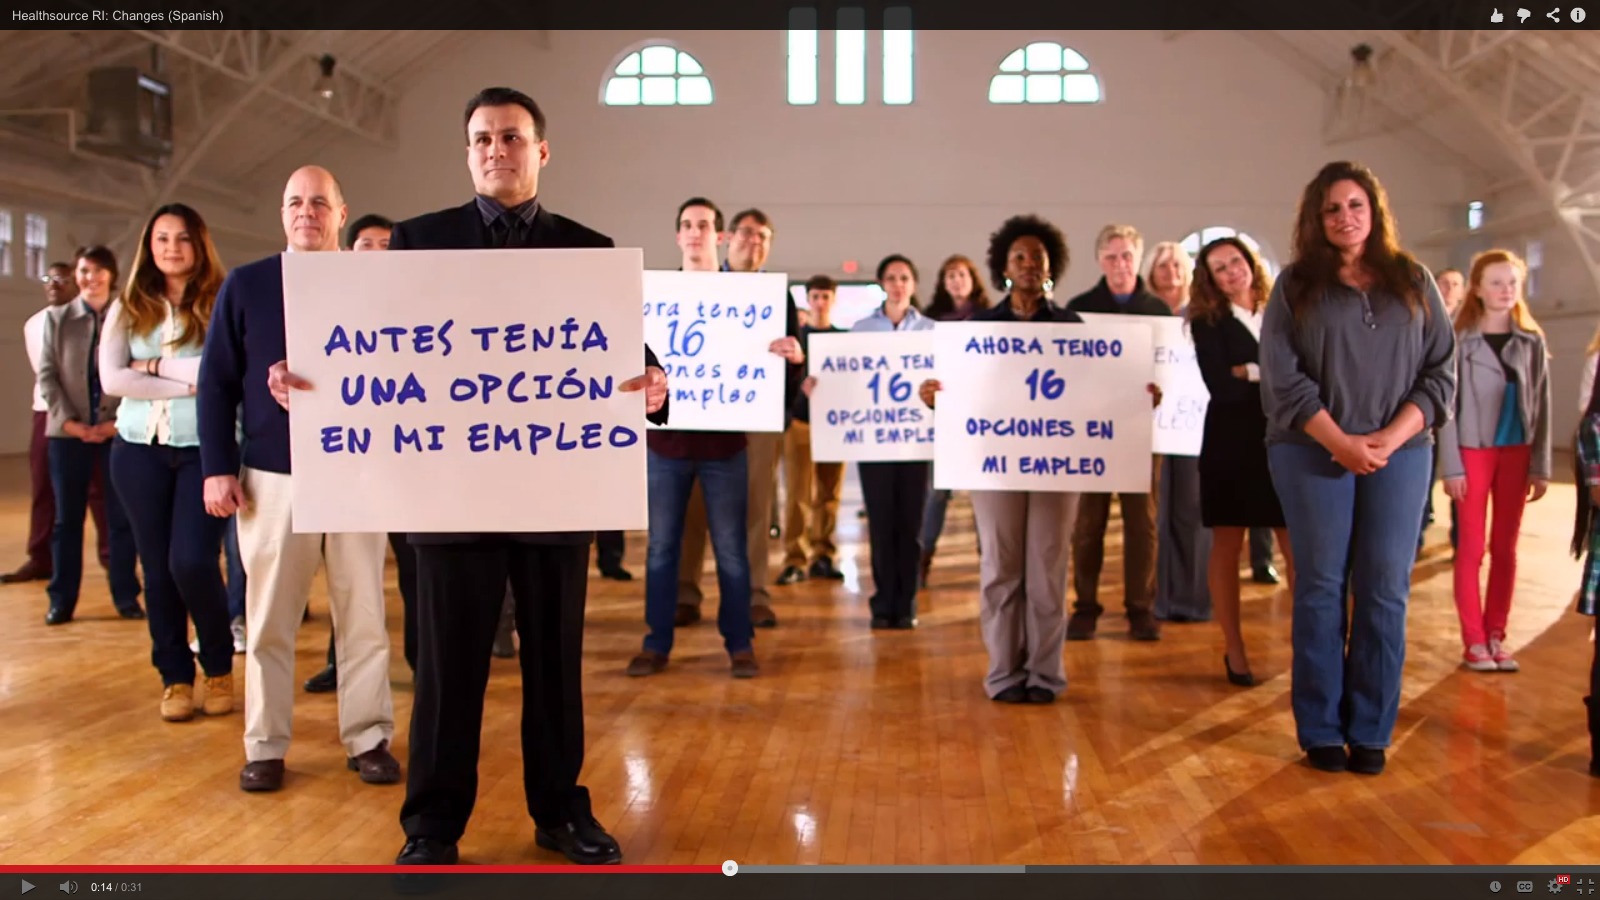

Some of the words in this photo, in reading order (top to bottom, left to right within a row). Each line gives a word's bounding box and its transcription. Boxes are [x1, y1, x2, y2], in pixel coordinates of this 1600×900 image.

[697, 302, 773, 329] tengo
[324, 319, 454, 356] ANTES
[470, 317, 608, 352] TENÍA
[665, 319, 706, 357] 16
[965, 336, 1043, 355] AHORA
[1052, 338, 1122, 357] TENGO
[821, 356, 889, 372] AHORA
[900, 354, 934, 369] TEN
[341, 372, 426, 405] UNA
[450, 368, 613, 404] OPCIÓN
[669, 383, 756, 410] mpleo
[867, 373, 911, 405] 16
[1025, 368, 1066, 401] 16
[827, 408, 923, 426] OPCIONES
[966, 418, 1075, 436] OPCIONES
[1086, 420, 1113, 440] EN
[1152, 410, 1197, 430] LEO
[321, 425, 372, 454] EN
[394, 424, 445, 453] MI
[467, 423, 638, 455] EMPLEO
[843, 429, 863, 443] MI
[982, 456, 1006, 473] MI
[1019, 457, 1106, 476] EMPLEO
